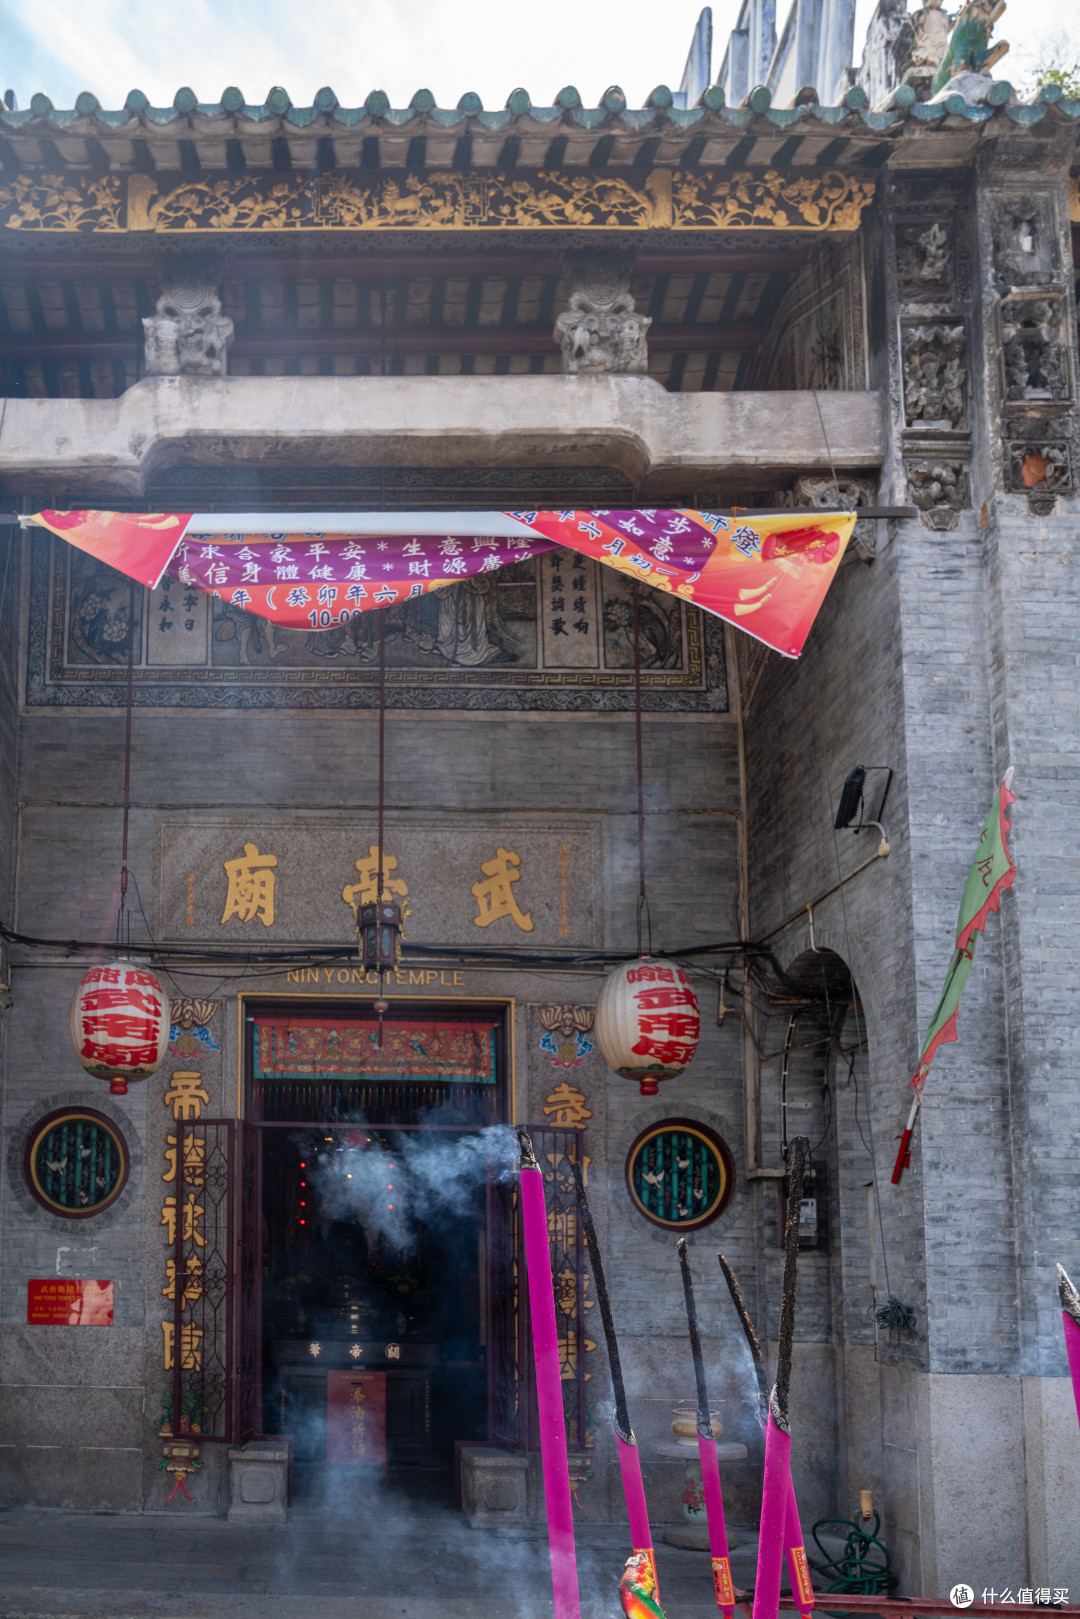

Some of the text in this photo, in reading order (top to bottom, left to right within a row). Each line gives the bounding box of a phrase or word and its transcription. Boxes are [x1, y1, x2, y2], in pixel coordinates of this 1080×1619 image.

[287, 968, 465, 986] NIN YONG TEMPLE
